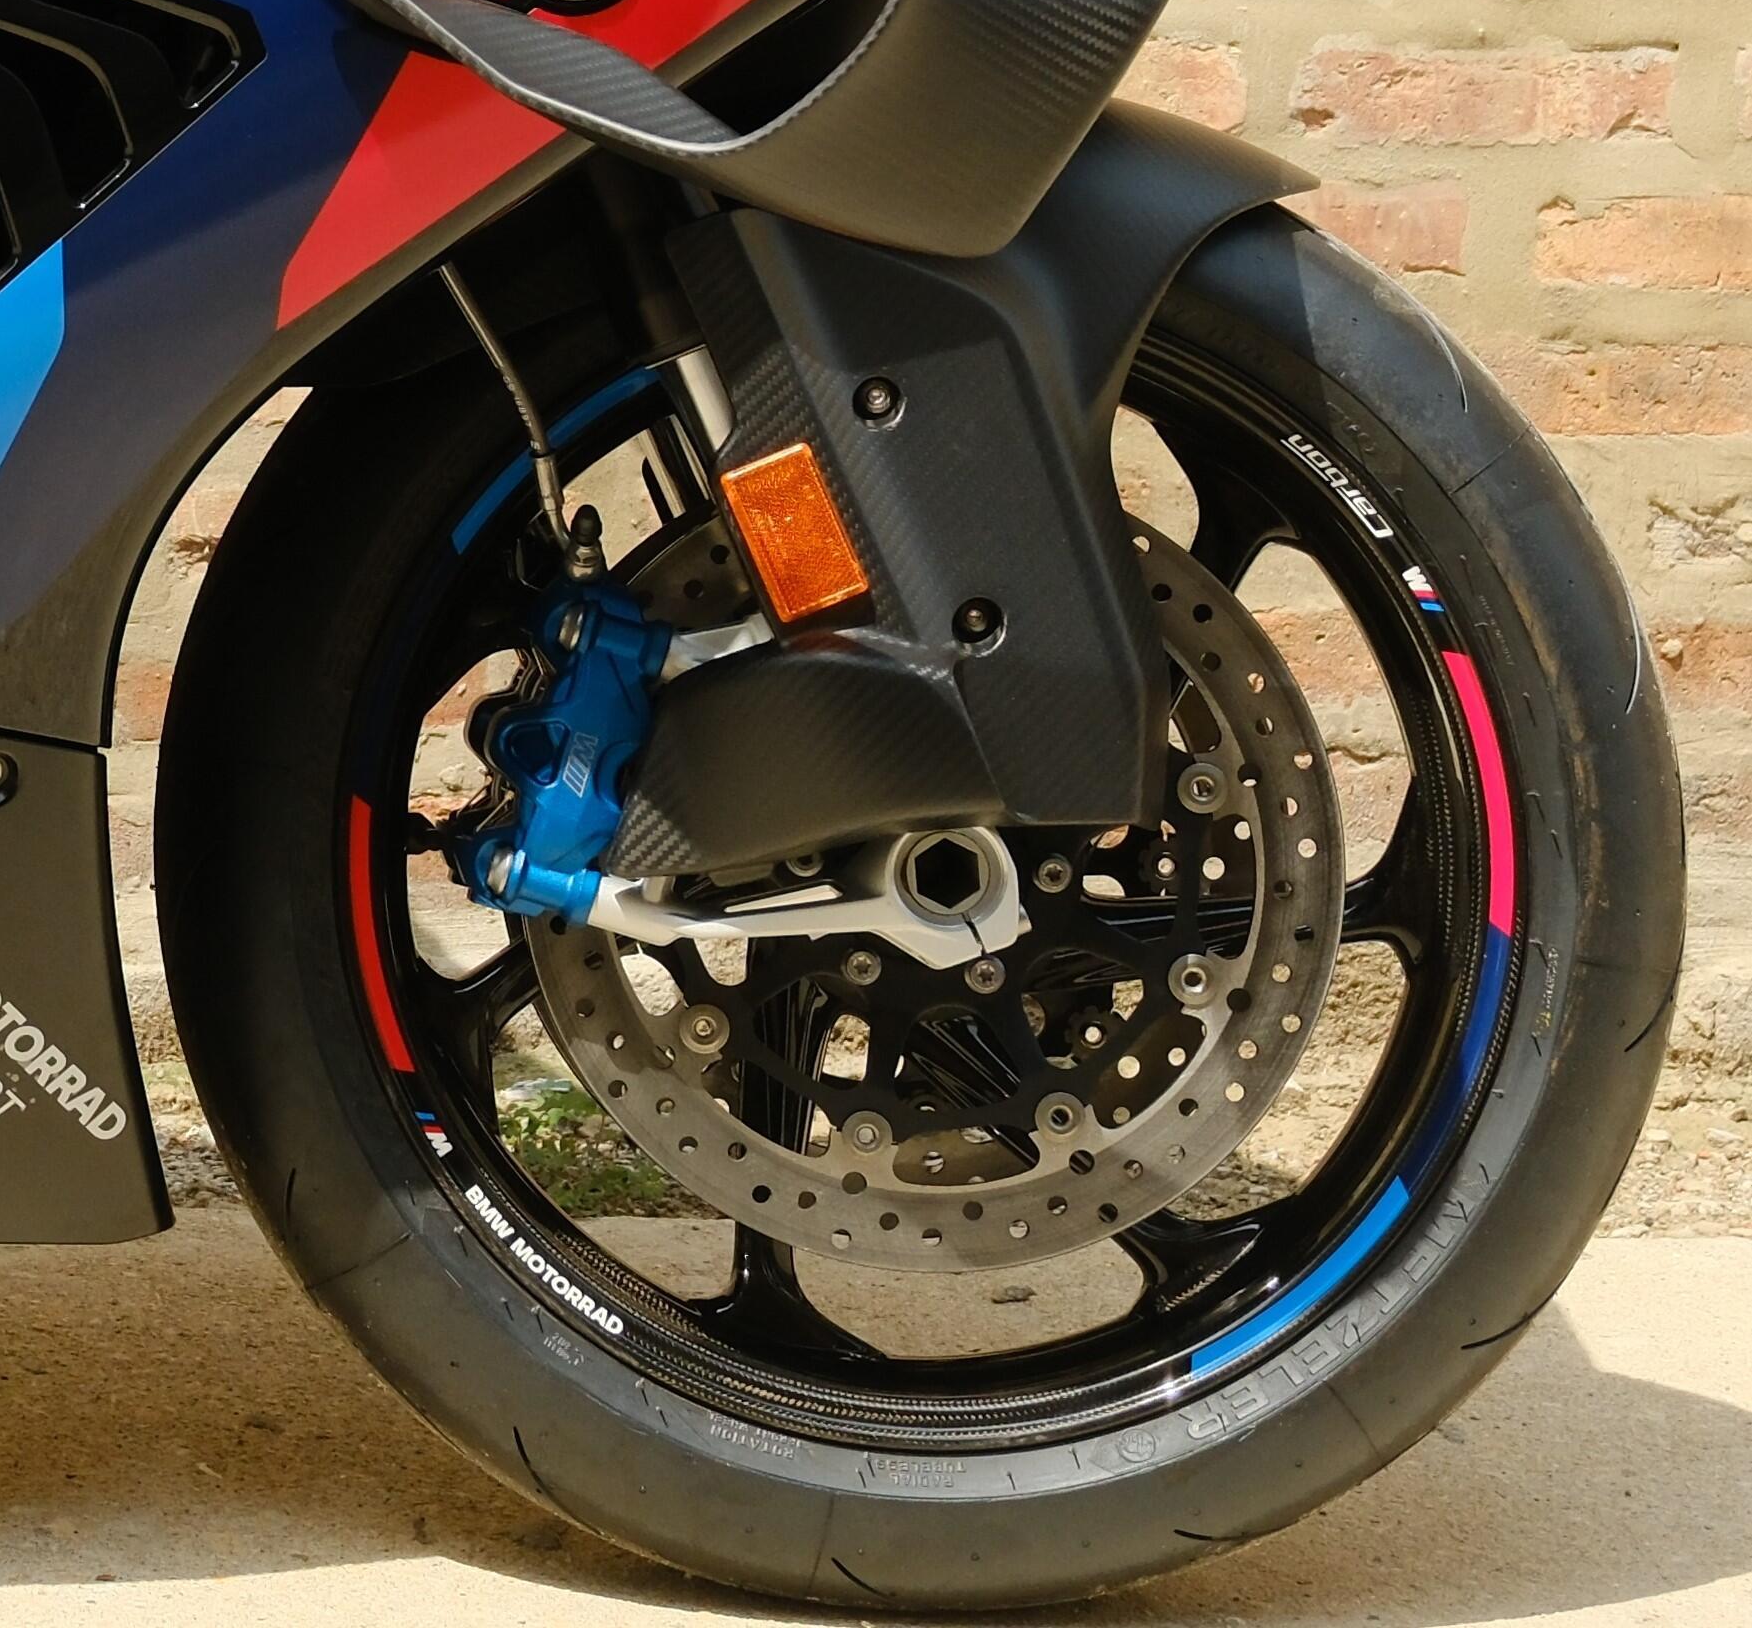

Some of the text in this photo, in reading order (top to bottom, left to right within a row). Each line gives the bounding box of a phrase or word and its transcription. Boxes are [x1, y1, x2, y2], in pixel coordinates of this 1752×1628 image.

[1280, 434, 1394, 538] Carbon
[465, 1184, 623, 1335] BMW MOTORRAD
[1177, 1198, 1477, 1440] METZELER
[710, 1424, 795, 1460] ROTATION
